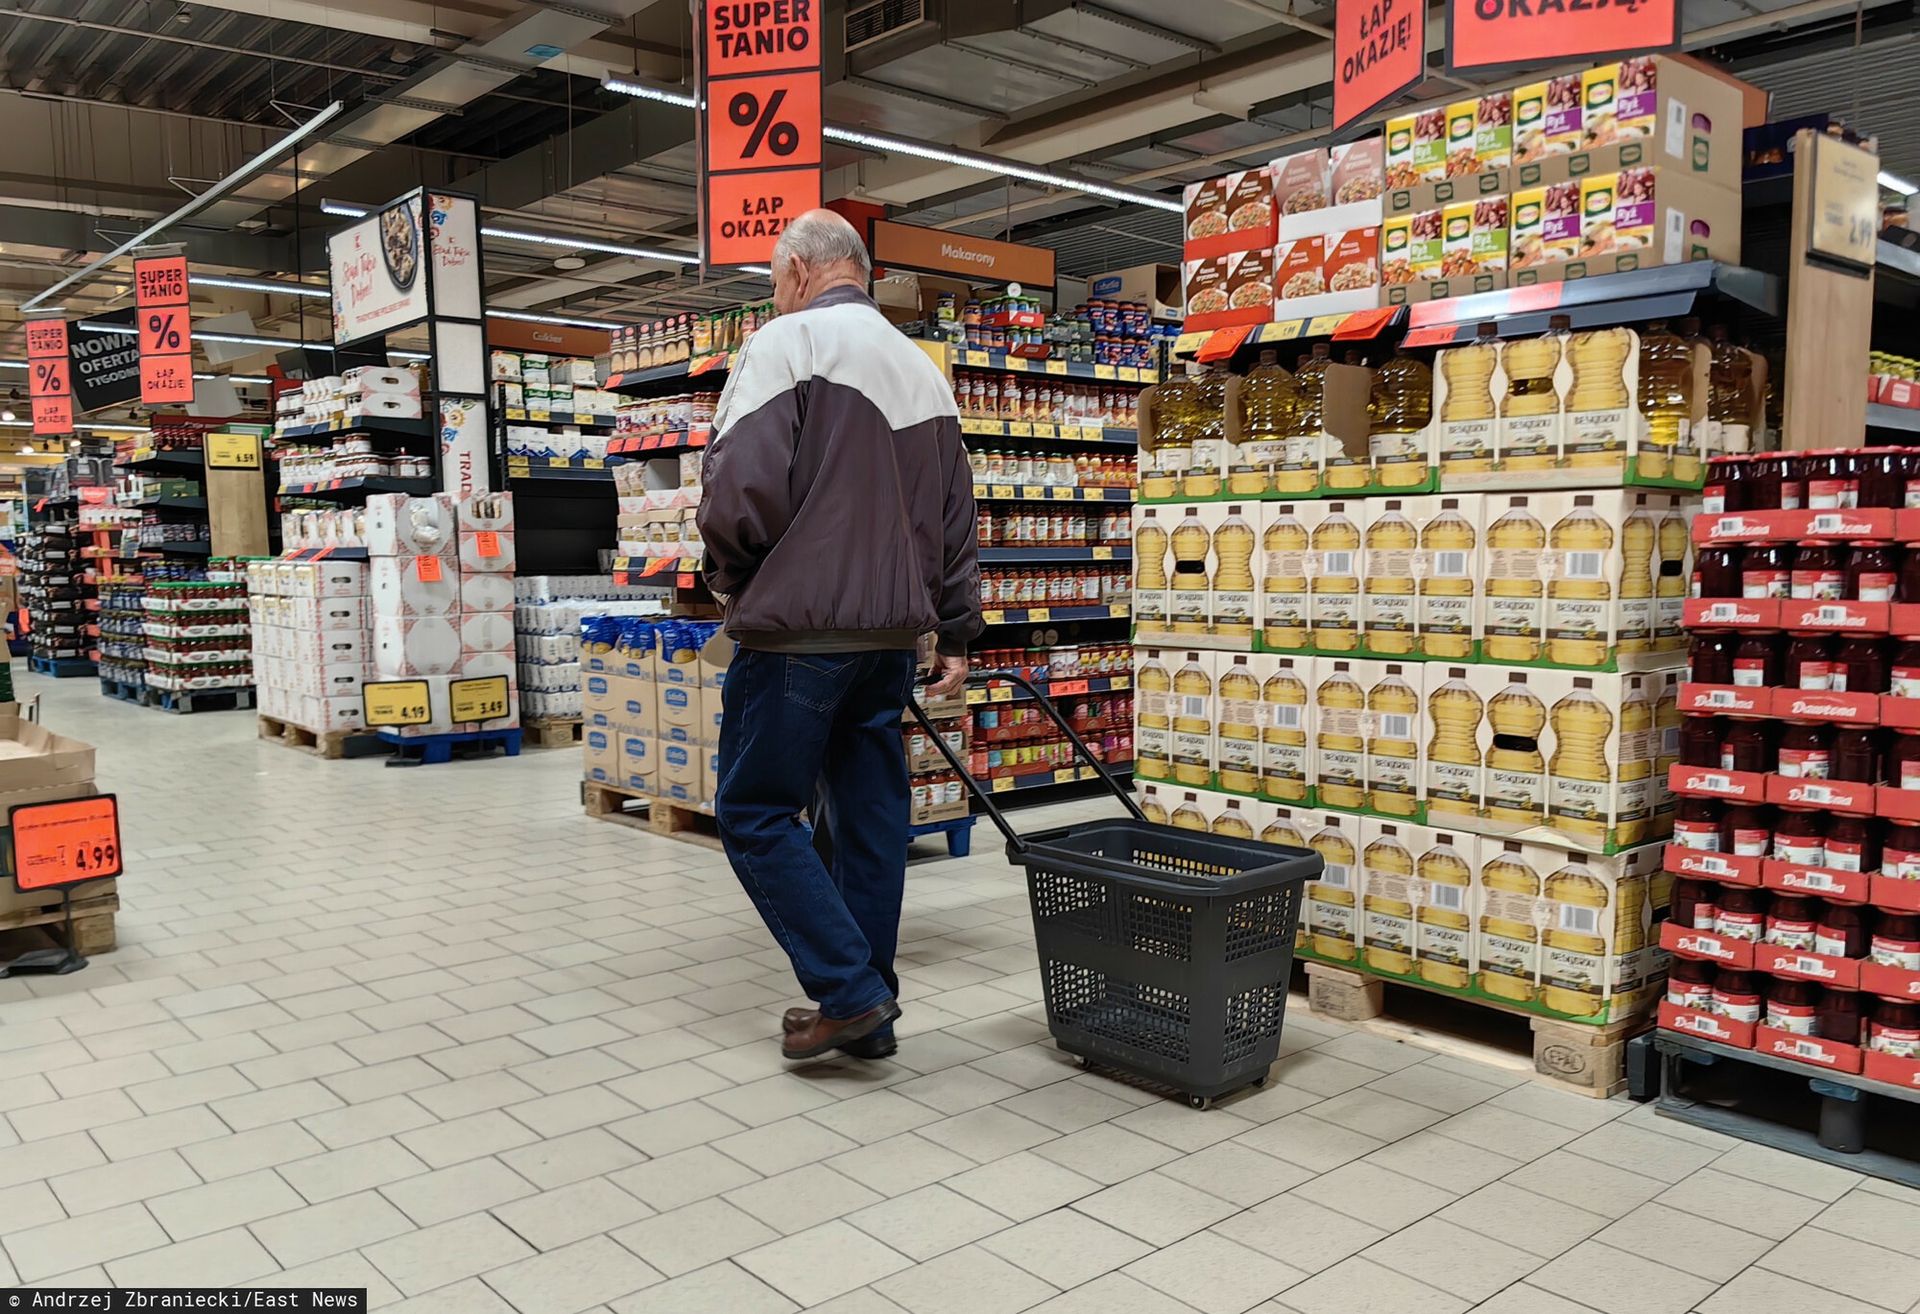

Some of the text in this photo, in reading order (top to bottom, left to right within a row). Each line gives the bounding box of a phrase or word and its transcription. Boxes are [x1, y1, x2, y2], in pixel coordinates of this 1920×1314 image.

[714, 0, 810, 30] SUPER
[1360, 0, 1392, 40] ŁAP
[716, 26, 809, 58] TANIO
[1343, 11, 1411, 84] OKAZJĘ!
[728, 89, 800, 158] %
[742, 196, 784, 216] ŁAP
[721, 217, 795, 239] OKAZ
[941, 244, 996, 268] Makarony
[140, 269, 183, 284] SUPER
[142, 283, 182, 298] TANIO
[149, 314, 180, 349] %
[70, 333, 136, 359] NOWA
[79, 349, 140, 374] OFERTA
[37, 363, 61, 391] %
[85, 366, 140, 388] TYGODNI
[1792, 701, 1857, 717] Dawtona
[76, 844, 115, 871] 4.99
